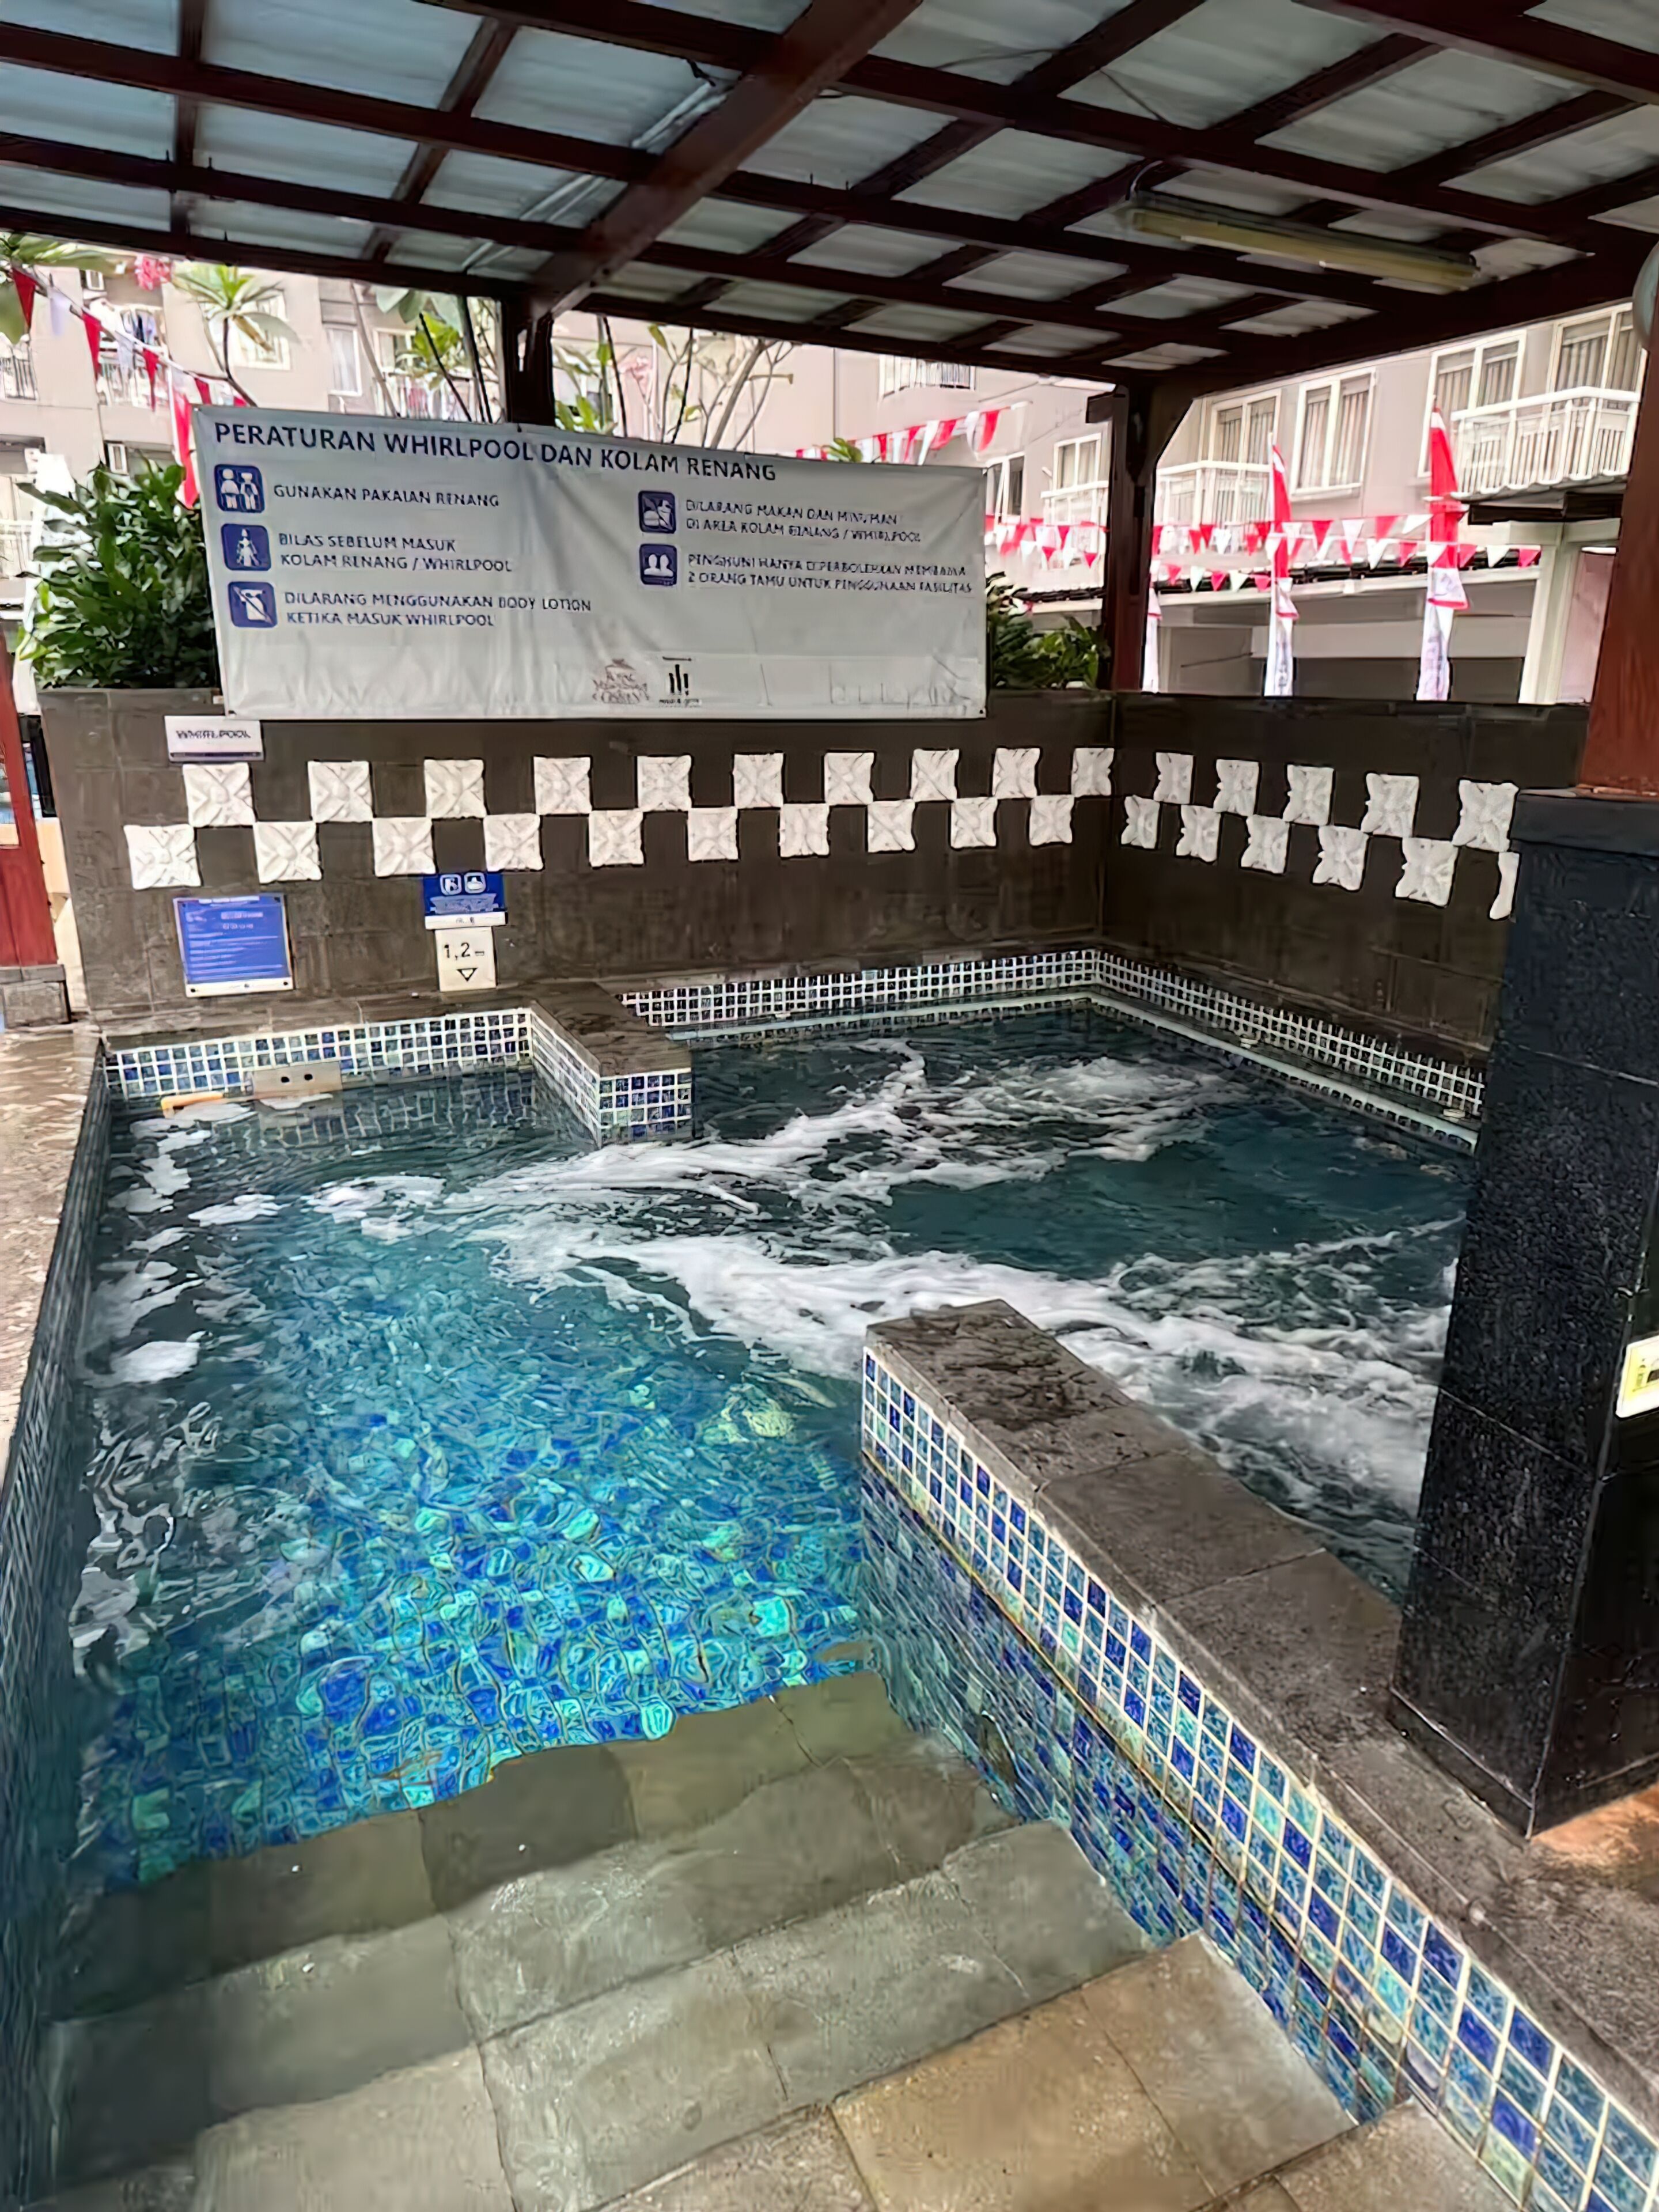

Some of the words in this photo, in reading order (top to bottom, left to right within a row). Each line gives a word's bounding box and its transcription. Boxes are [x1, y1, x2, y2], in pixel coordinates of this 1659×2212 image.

[215, 422, 376, 452] PERATURAN
[384, 433, 533, 461] WHIRLPOOL
[541, 444, 592, 468] DAN
[601, 449, 679, 474] KOLAM
[688, 457, 776, 481] RENANG
[274, 484, 357, 501] GUNAKAN
[362, 488, 431, 504] PAKAIAN
[436, 492, 499, 507] RENANG
[741, 522, 784, 536] KOLAM
[279, 533, 324, 547] BILAS
[328, 536, 397, 548] SEBELUM
[403, 537, 456, 553] MASUK
[281, 554, 336, 567] KOLAM
[342, 555, 408, 569] RENANG
[422, 558, 513, 572] WHIRLPOOL
[284, 592, 367, 606] DILARANG
[373, 593, 493, 608] MENGGUNAKAN
[499, 597, 536, 609] BODY
[542, 598, 592, 612] LOTION
[287, 612, 344, 625] KETIKA
[347, 613, 403, 626] MASUK
[405, 614, 495, 627] WHIRLPOOL
